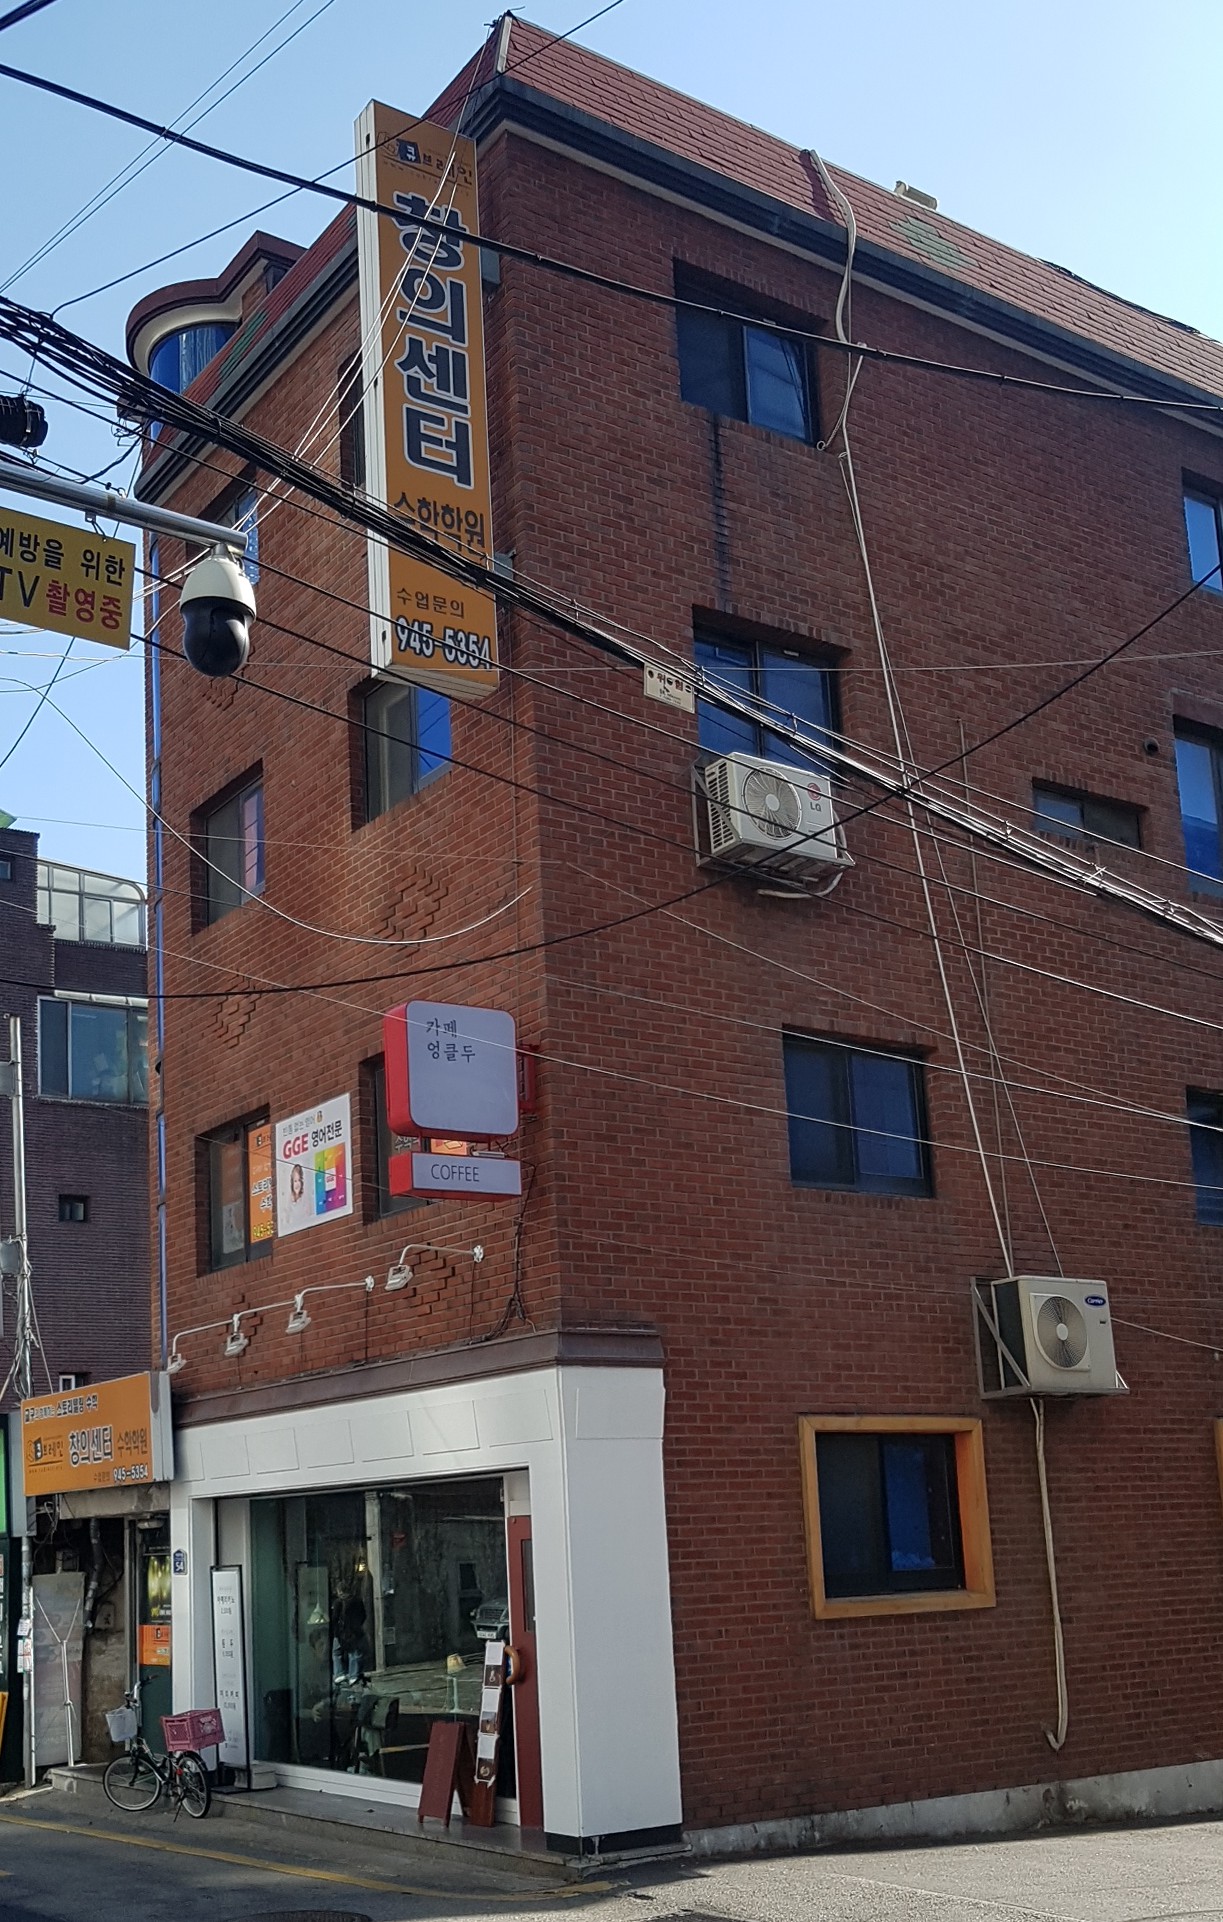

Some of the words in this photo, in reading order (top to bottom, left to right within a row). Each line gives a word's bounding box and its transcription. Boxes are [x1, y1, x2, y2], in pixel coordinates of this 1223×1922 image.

[393, 191, 474, 490] 창의센터
[80, 548, 126, 587] 위한
[397, 587, 465, 619] 수업문의
[395, 615, 492, 671] 945-5354
[809, 801, 822, 812] LG
[427, 1040, 476, 1063] 엉클두
[282, 1132, 309, 1160] GGE
[311, 1119, 343, 1148] 영어전문
[430, 1163, 480, 1182] COFFEE
[69, 1425, 114, 1467] 창의센터
[112, 1464, 149, 1482] 945-5354
